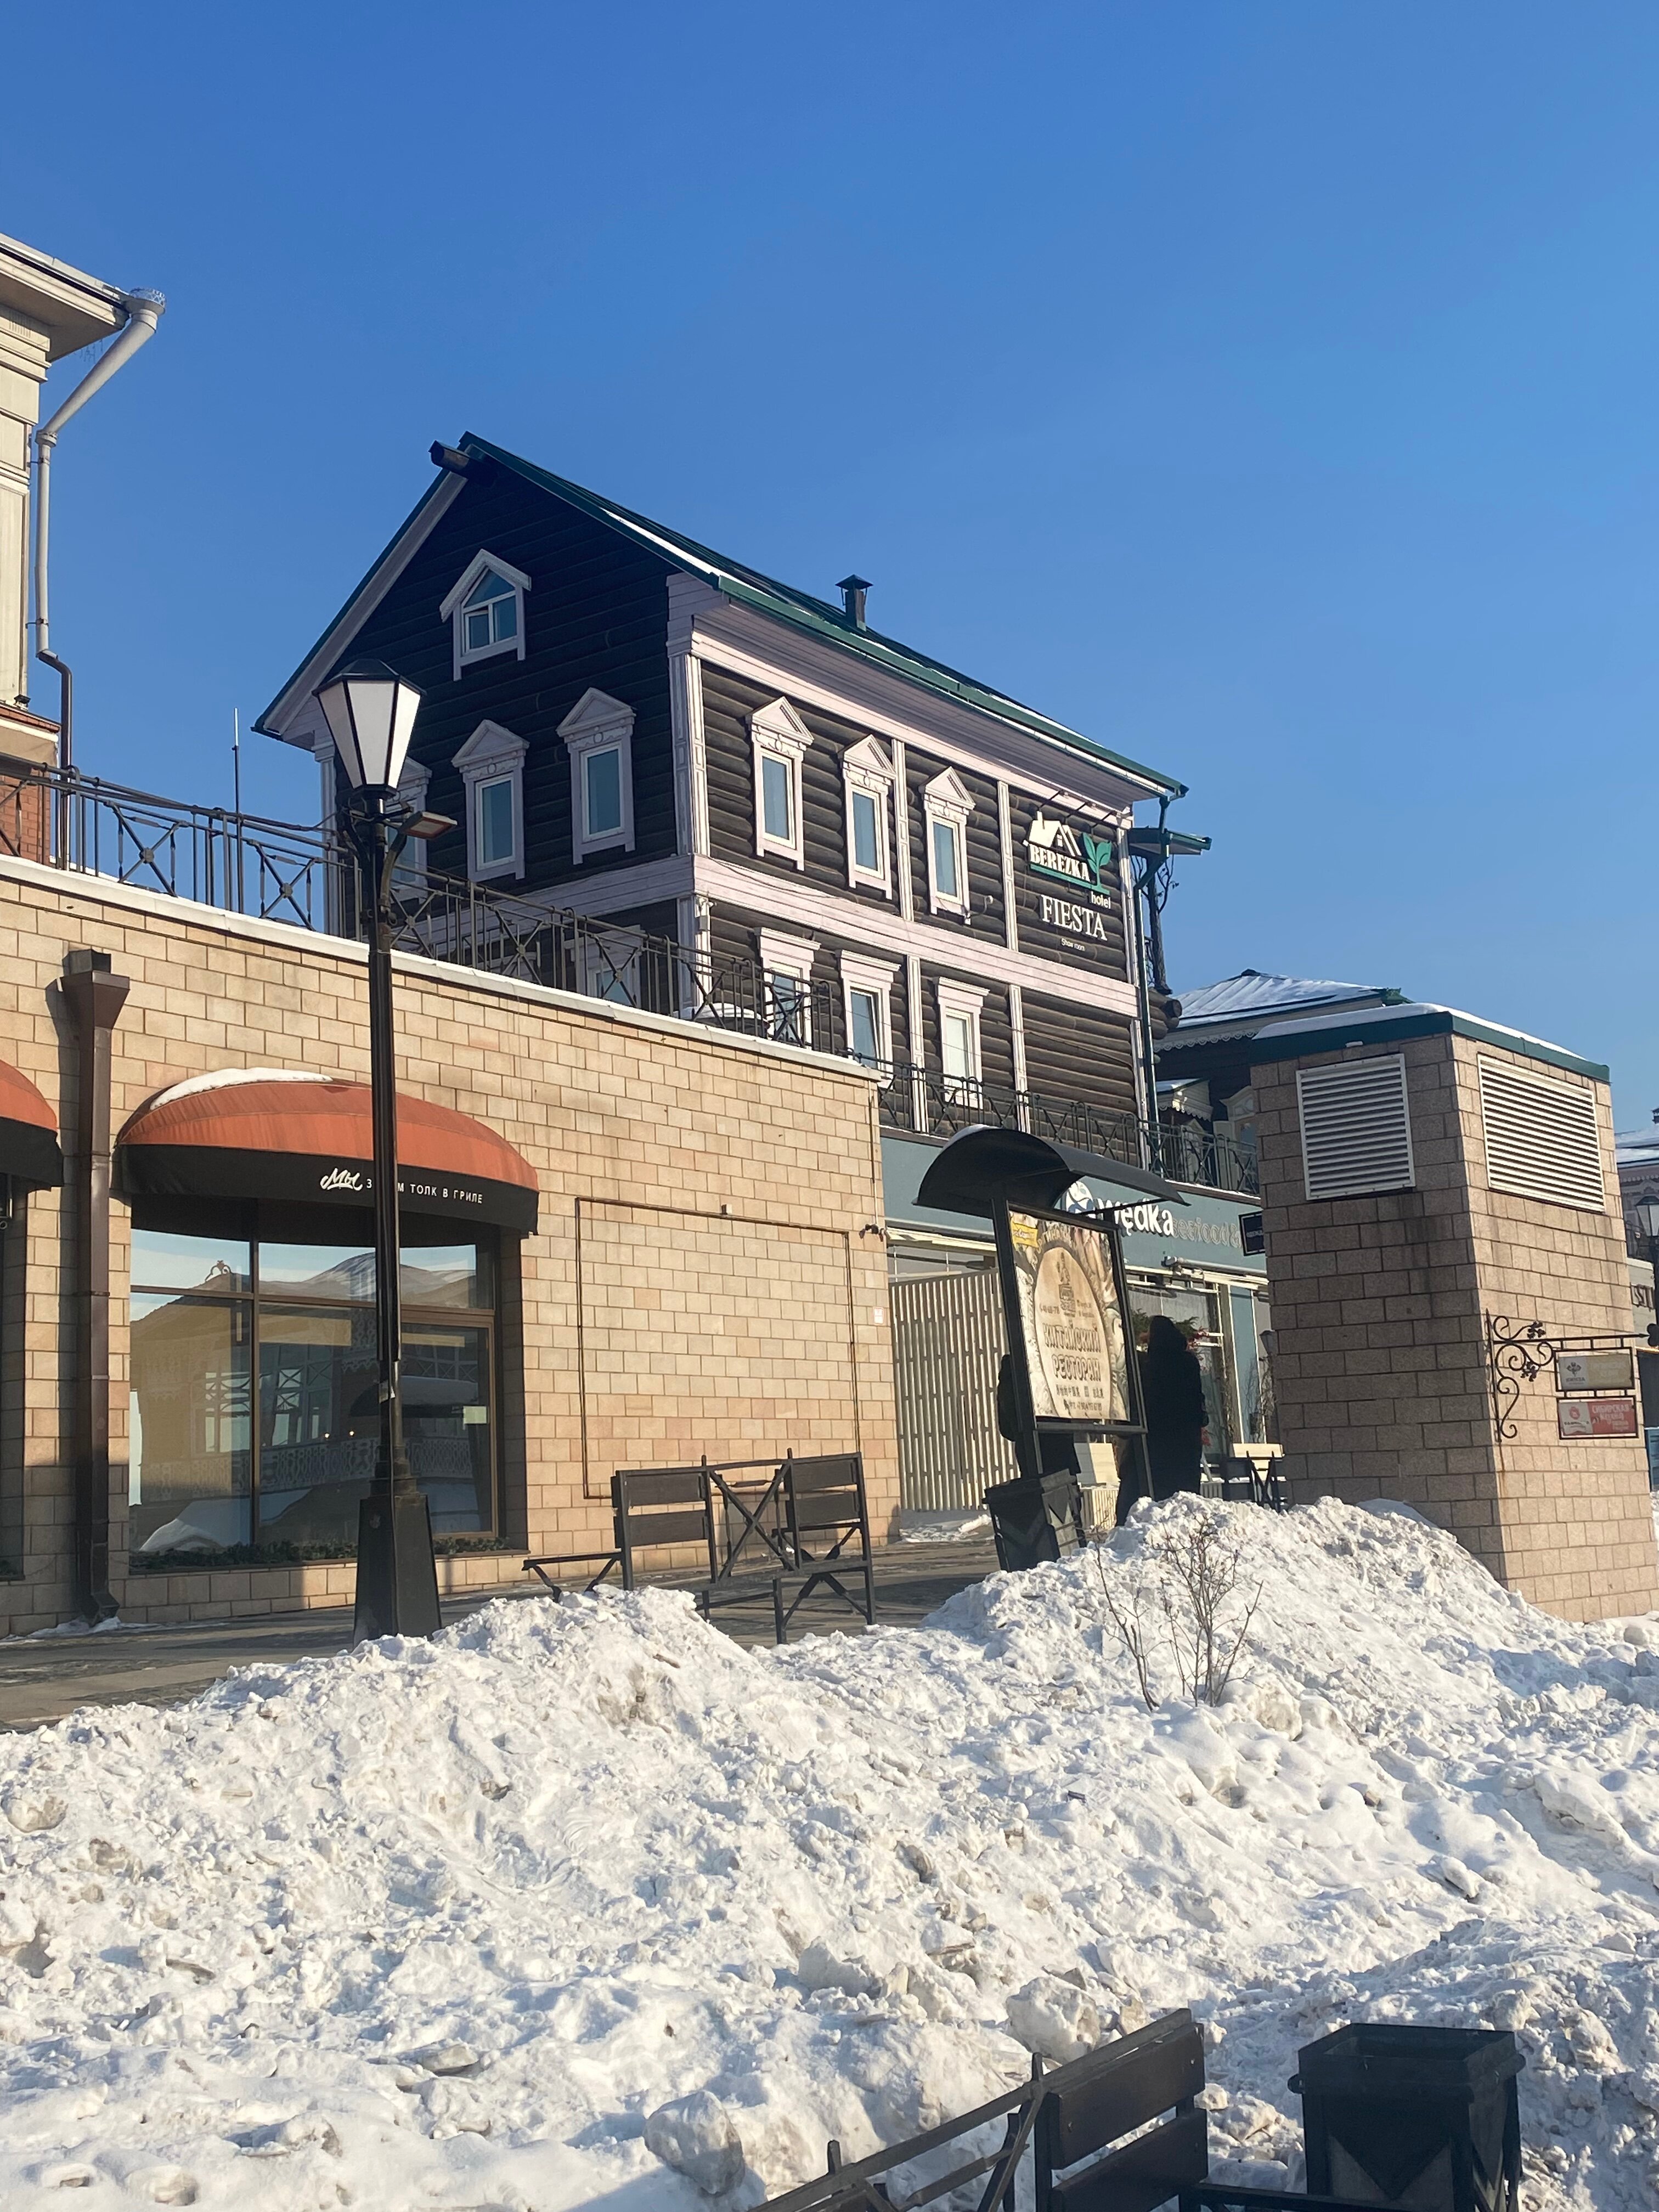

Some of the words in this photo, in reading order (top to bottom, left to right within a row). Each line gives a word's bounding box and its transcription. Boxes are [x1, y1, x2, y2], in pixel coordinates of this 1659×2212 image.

[1029, 844, 1091, 882] BEREZKA
[1041, 894, 1108, 941] FIESTA
[1090, 891, 1111, 909] hotel
[319, 1167, 363, 1190] Мы
[410, 1183, 437, 1197] ТОЛК
[443, 1188, 448, 1198] В
[453, 1189, 483, 1205] ГРИЛЕ
[1042, 1319, 1101, 1353] КИТАЙСКИЙ
[1052, 1353, 1101, 1382] РЕСТОРАН
